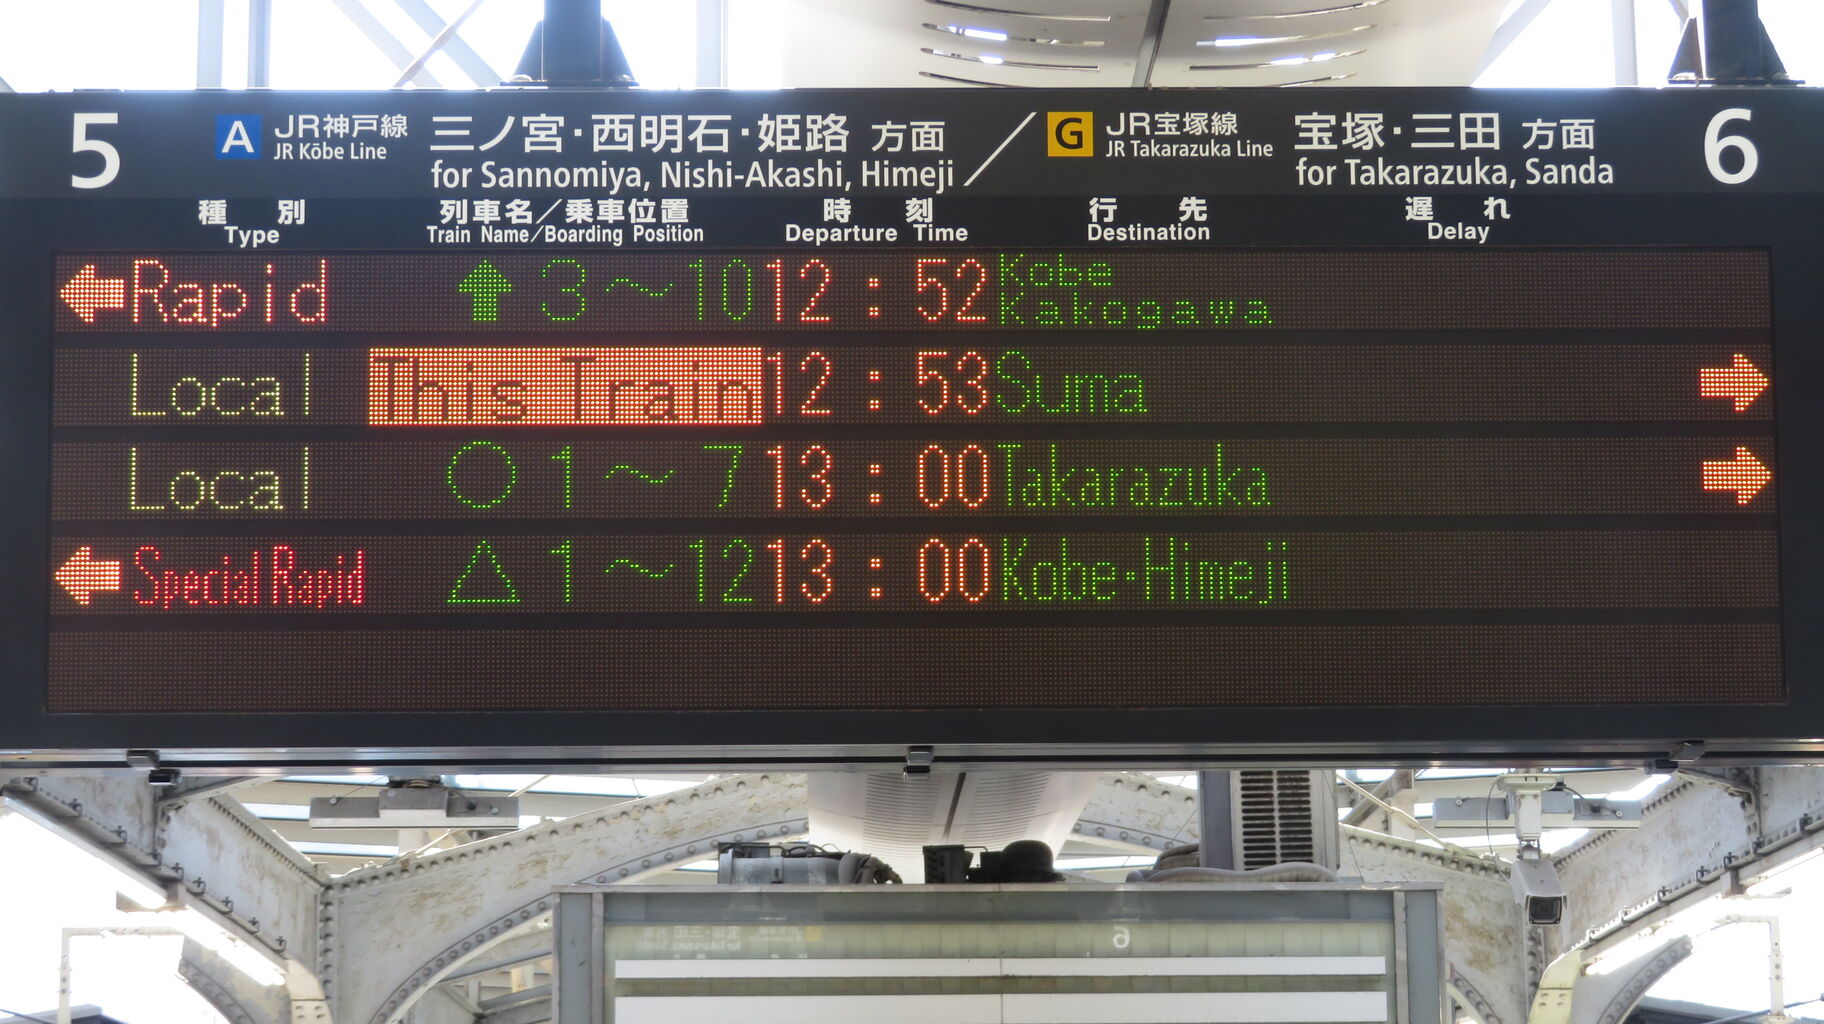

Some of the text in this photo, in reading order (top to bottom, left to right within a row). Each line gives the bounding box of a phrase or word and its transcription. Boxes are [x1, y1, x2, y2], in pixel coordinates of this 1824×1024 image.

[221, 120, 255, 153] A
[274, 113, 408, 139] JR神戸線
[871, 120, 945, 152] 方面
[1055, 117, 1084, 150] G
[1106, 111, 1238, 136] JR宝塚線
[1521, 118, 1595, 150] 方面
[71, 112, 121, 189] 5
[273, 141, 387, 160] JR Kōbe Line
[1105, 138, 1273, 157] JR Takarazuka Line
[1704, 108, 1758, 185] 6
[430, 158, 953, 195] for Sannomiya, Nishi-Akashi, Himeji
[1295, 155, 1614, 189] for Takarazuka, Sanda
[223, 225, 280, 248] Type
[426, 221, 471, 244] Train
[630, 221, 704, 242] Position
[785, 223, 968, 246] Departure Time
[1088, 222, 1210, 241] Destination
[1428, 222, 1490, 244] Delay
[999, 253, 1113, 287] Kobe
[132, 258, 328, 327] Rapid
[999, 291, 1274, 329] Kakogawa
[131, 353, 311, 416] Local
[370, 354, 530, 420] This
[560, 354, 758, 420] Train
[995, 350, 1148, 414] Suma
[130, 446, 310, 510] Local
[997, 443, 1271, 507] Takarazuka
[133, 545, 261, 610] Special
[271, 545, 366, 609] Rapid
